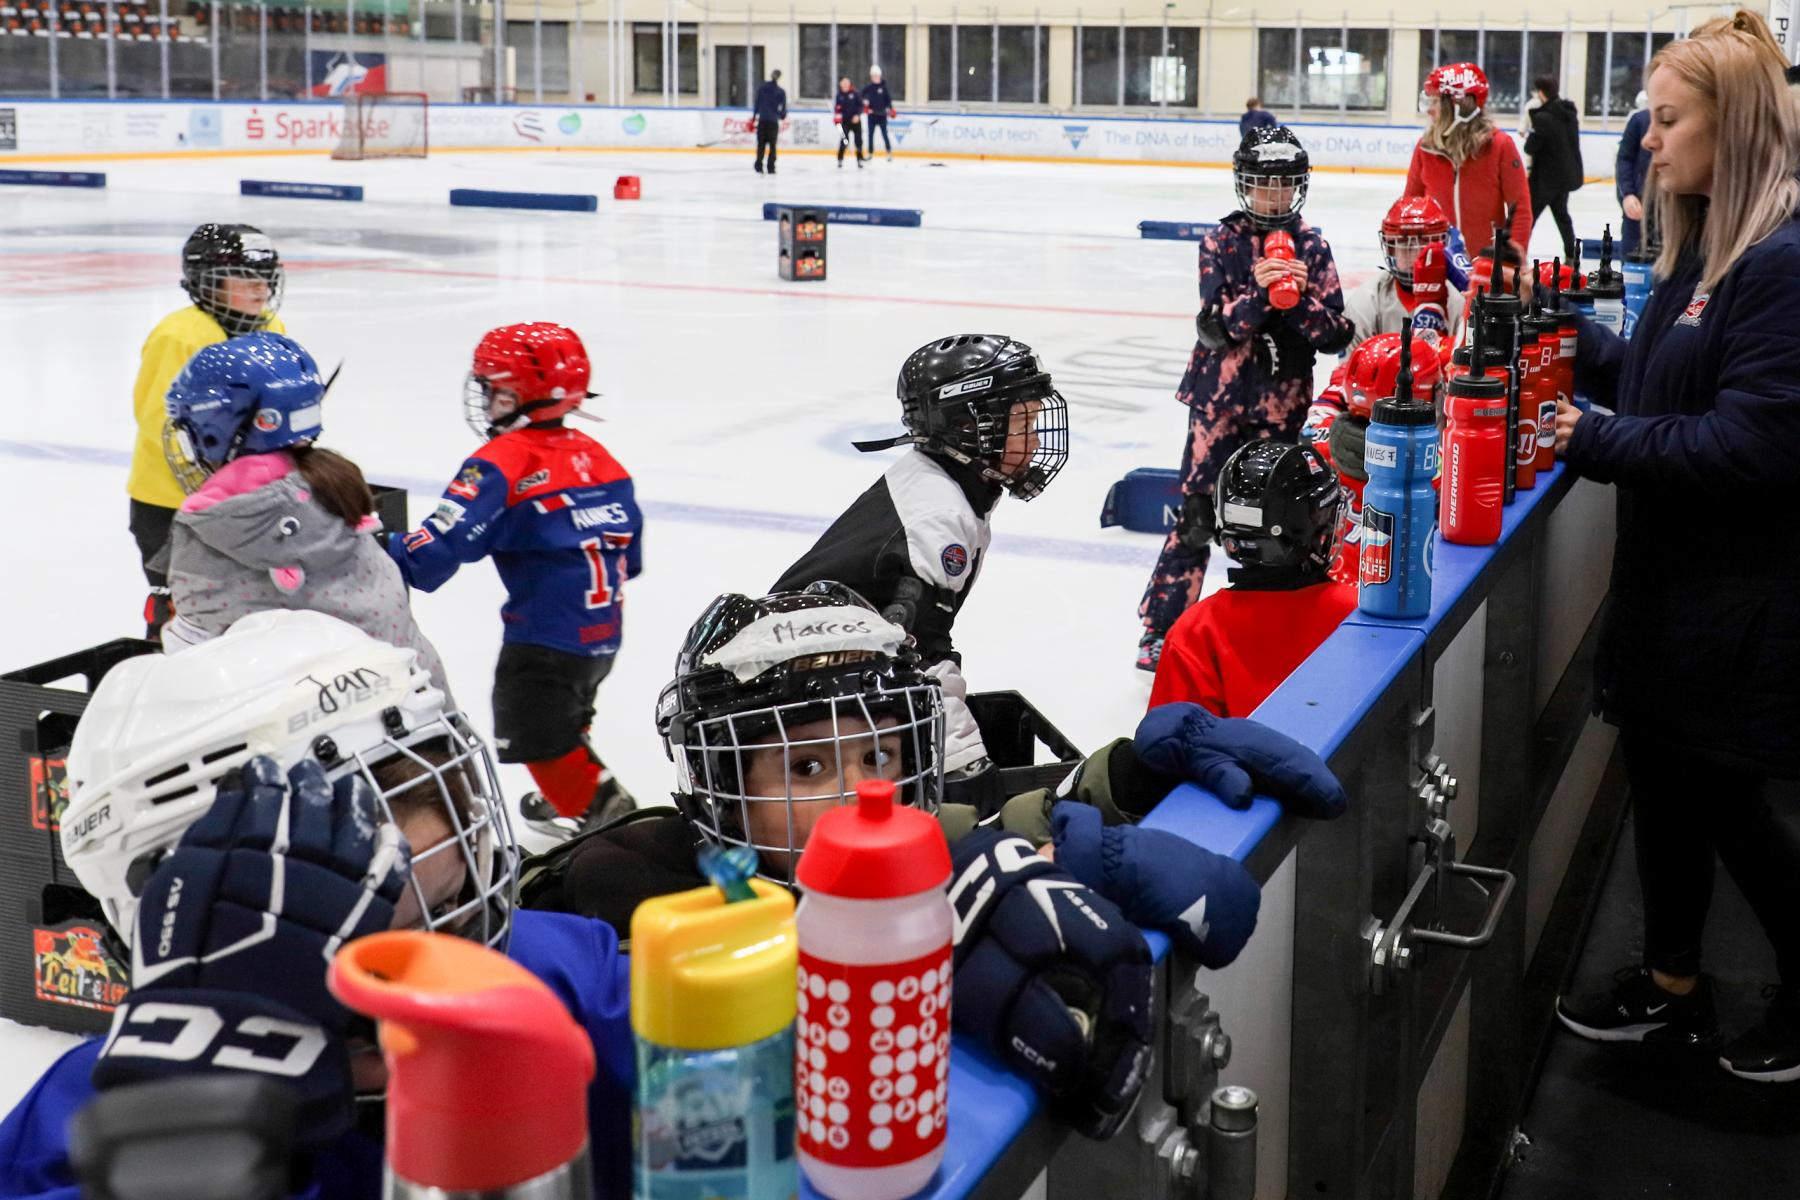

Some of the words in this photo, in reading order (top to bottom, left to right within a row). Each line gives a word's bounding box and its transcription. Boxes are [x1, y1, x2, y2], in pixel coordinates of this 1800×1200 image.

[275, 112, 389, 145] Sparkasse
[953, 125, 985, 140] DNA
[1104, 129, 1131, 145] The
[1136, 130, 1169, 146] DNA
[1172, 132, 1188, 147] of
[1326, 137, 1361, 152] DNA
[1449, 443, 1460, 528] SHERWOOD
[772, 619, 872, 644] Marcos
[792, 650, 877, 673] BAUER
[295, 665, 383, 713] Jan
[1011, 1035, 1058, 1072] CCM
